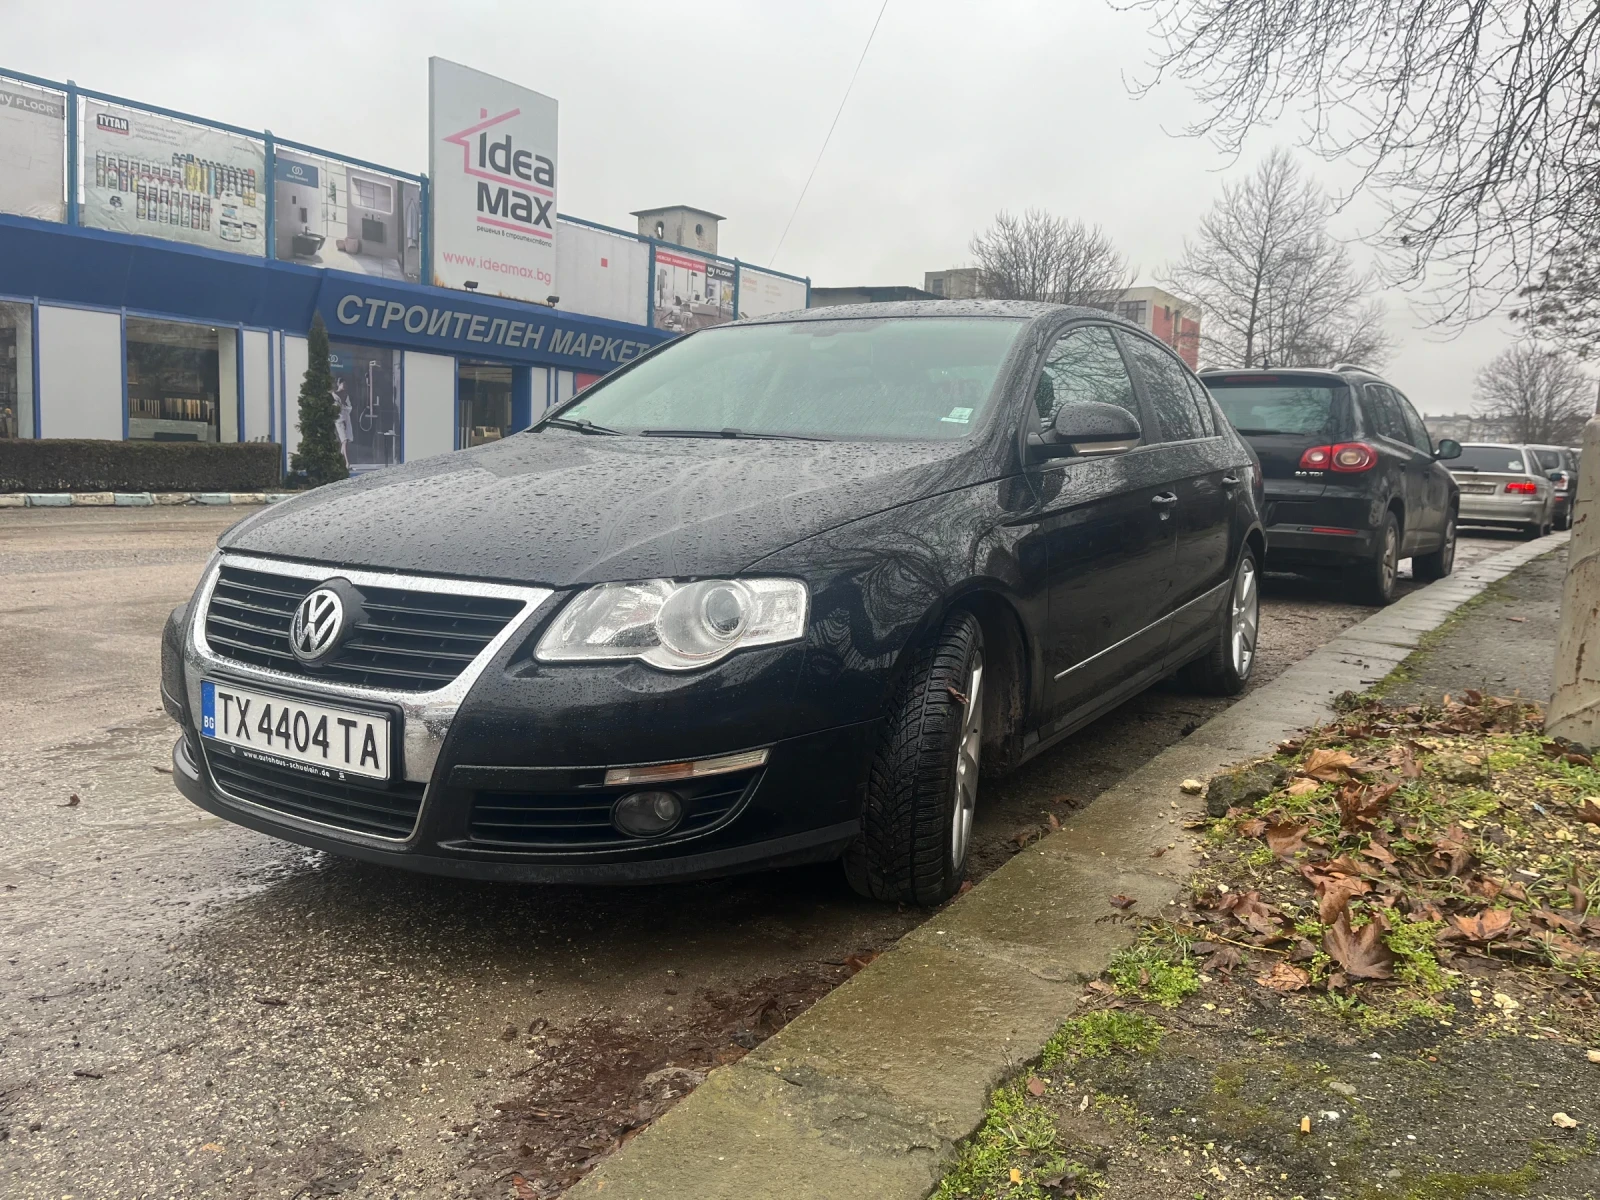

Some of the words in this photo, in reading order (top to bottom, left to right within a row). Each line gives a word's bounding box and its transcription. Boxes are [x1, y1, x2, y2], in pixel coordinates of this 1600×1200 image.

[16, 98, 54, 114] FLOOR
[98, 114, 127, 131] TYTAN
[477, 181, 553, 230] Max
[476, 225, 500, 236] решения
[442, 251, 552, 286] www.ideamax.bg
[336, 294, 545, 350] СТРОИТЕЛЕН
[548, 328, 651, 364] МАРКЕТ
[203, 715, 215, 730] BG
